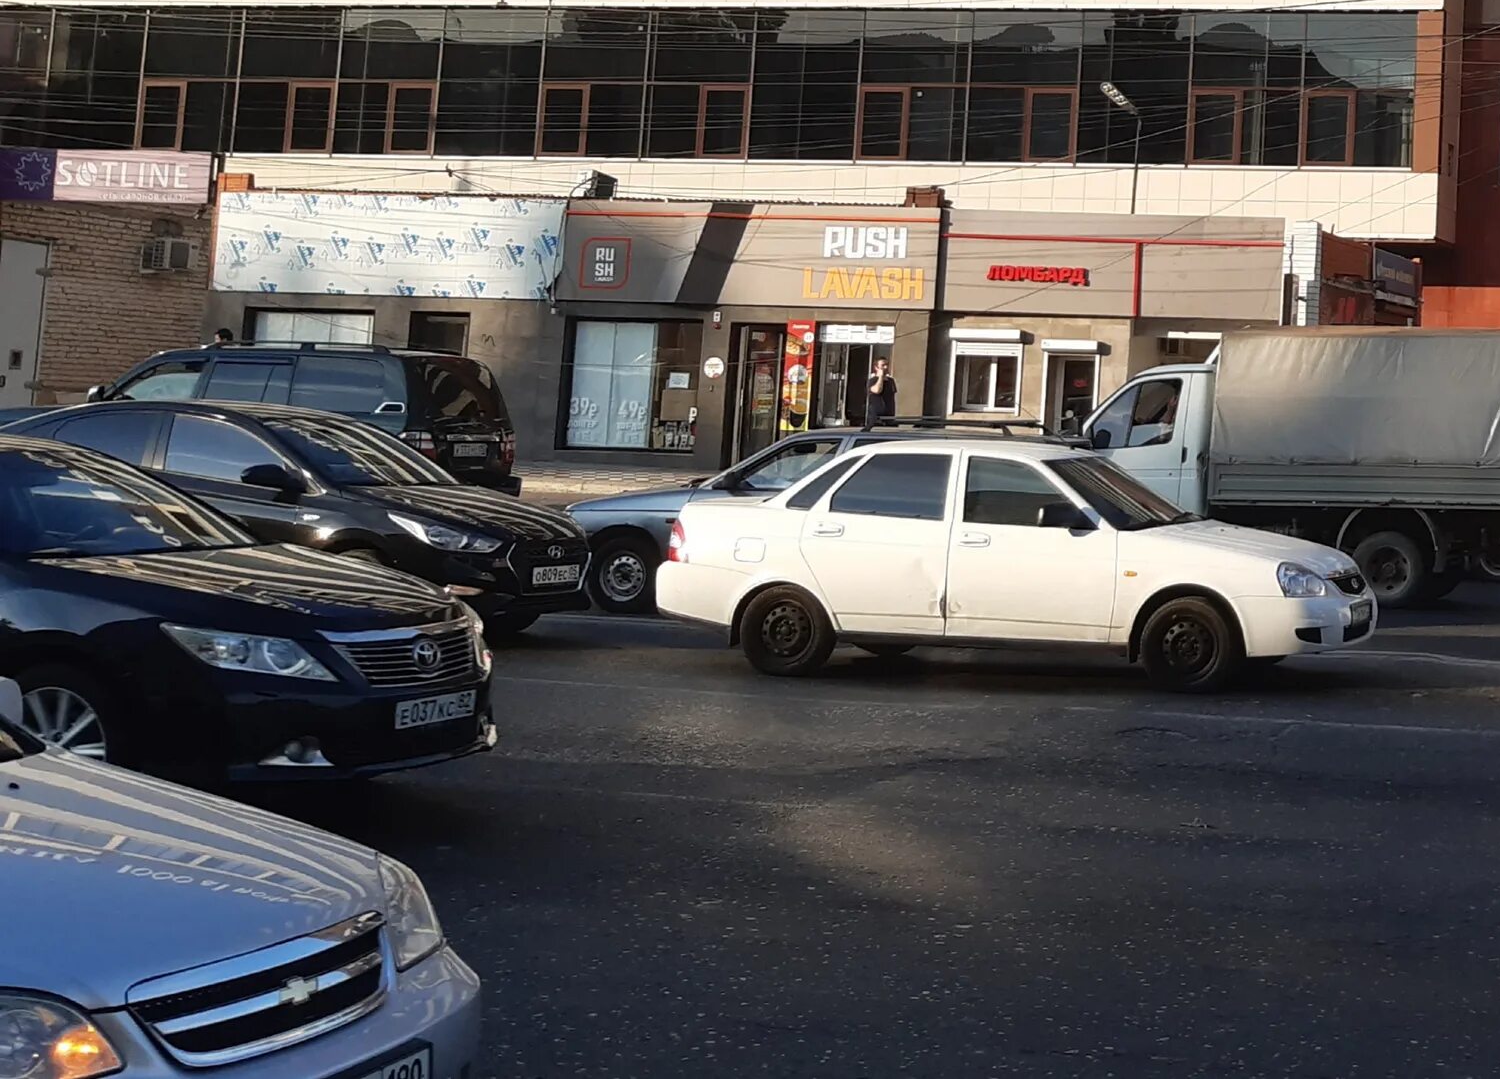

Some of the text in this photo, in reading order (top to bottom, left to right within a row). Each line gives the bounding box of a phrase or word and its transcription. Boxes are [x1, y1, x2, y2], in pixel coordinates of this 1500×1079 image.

[823, 226, 908, 259] RUSH
[595, 248, 615, 261] RU
[594, 262, 614, 276] SH
[987, 265, 1087, 286] ЛОМБАРД
[802, 266, 925, 301] LAVASH
